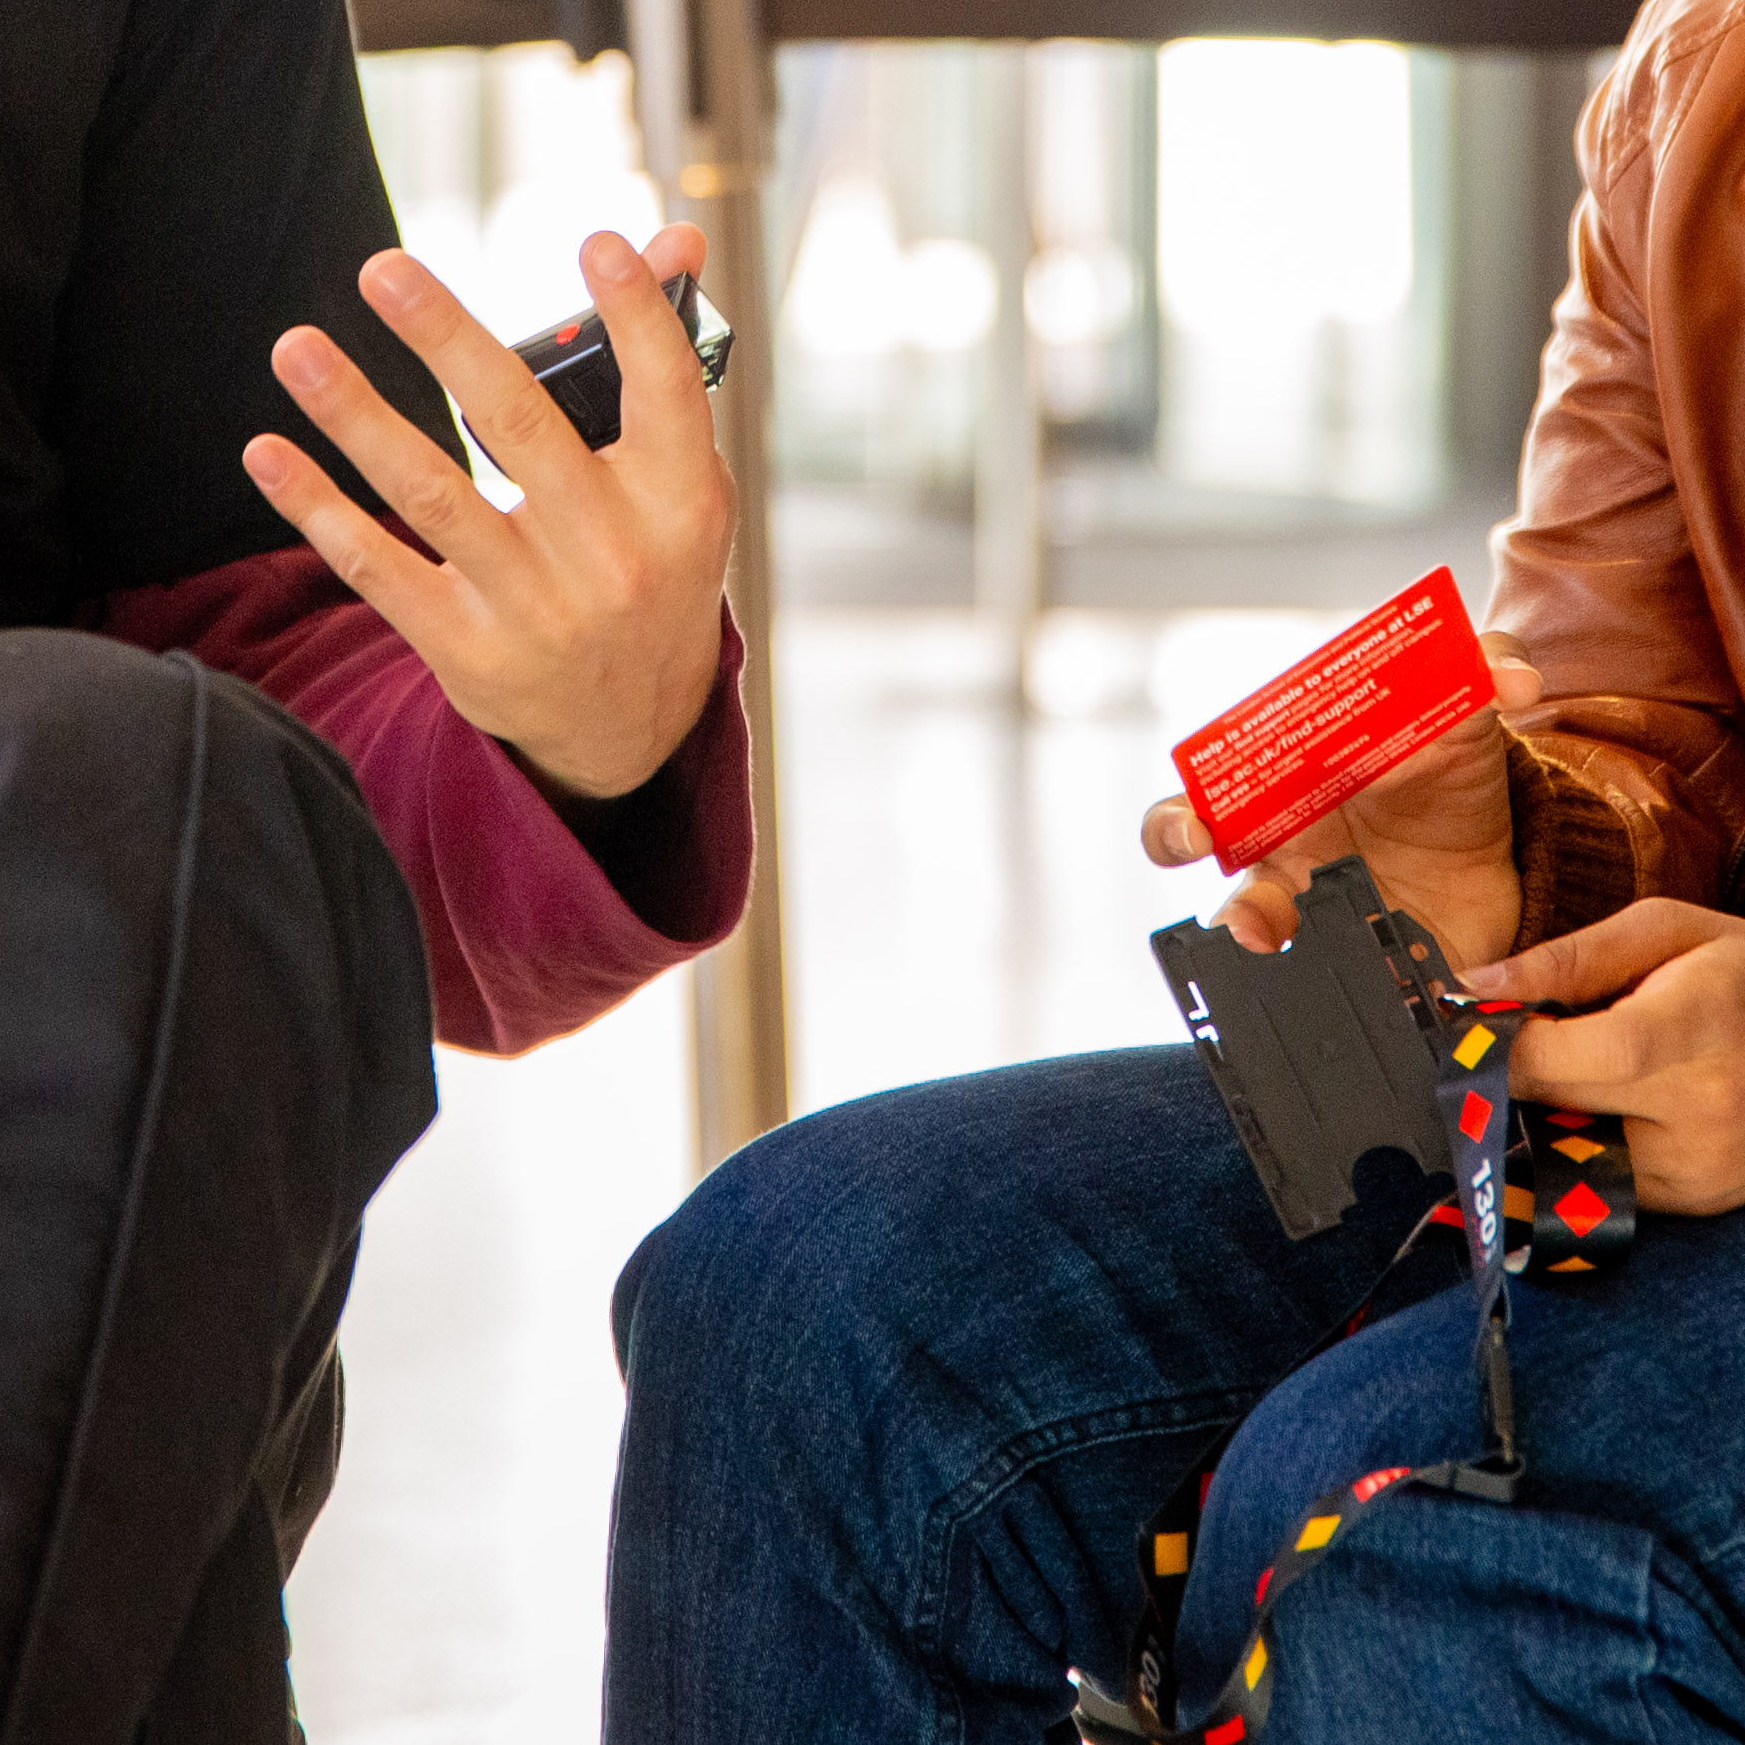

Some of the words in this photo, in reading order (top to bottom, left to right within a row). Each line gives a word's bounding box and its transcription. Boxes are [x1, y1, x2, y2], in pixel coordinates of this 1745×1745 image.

[1189, 739, 1224, 766] Help
[1225, 729, 1240, 742] is
[1242, 686, 1303, 731] available
[1304, 674, 1321, 688] to
[1322, 631, 1383, 676] everyone
[1388, 617, 1403, 633] at
[1403, 596, 1432, 621] LSE
[1205, 679, 1375, 799] lse.ac.uk/find-support
[1210, 795, 1230, 812] Call
[1472, 1158, 1497, 1246] 130
